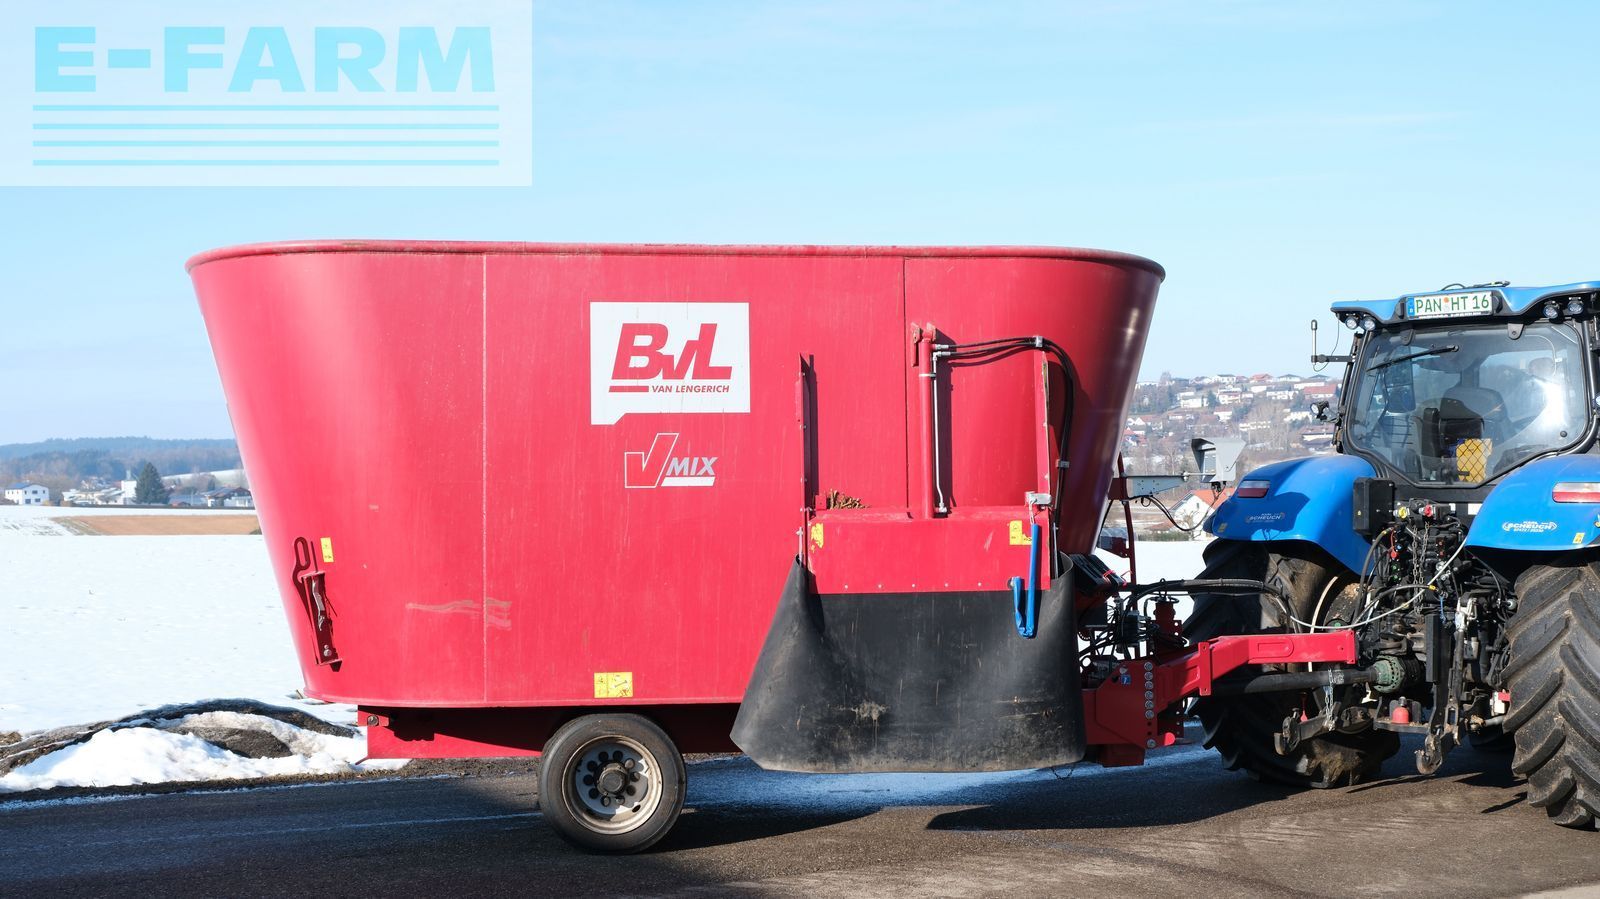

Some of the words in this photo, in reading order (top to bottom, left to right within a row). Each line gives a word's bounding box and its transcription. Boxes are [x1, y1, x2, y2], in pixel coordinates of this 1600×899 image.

[1415, 298, 1442, 313] PAN
[1451, 296, 1469, 311] HT
[1472, 294, 1490, 310] 16
[651, 385, 673, 393] VAN
[675, 385, 730, 393] LENGERICH
